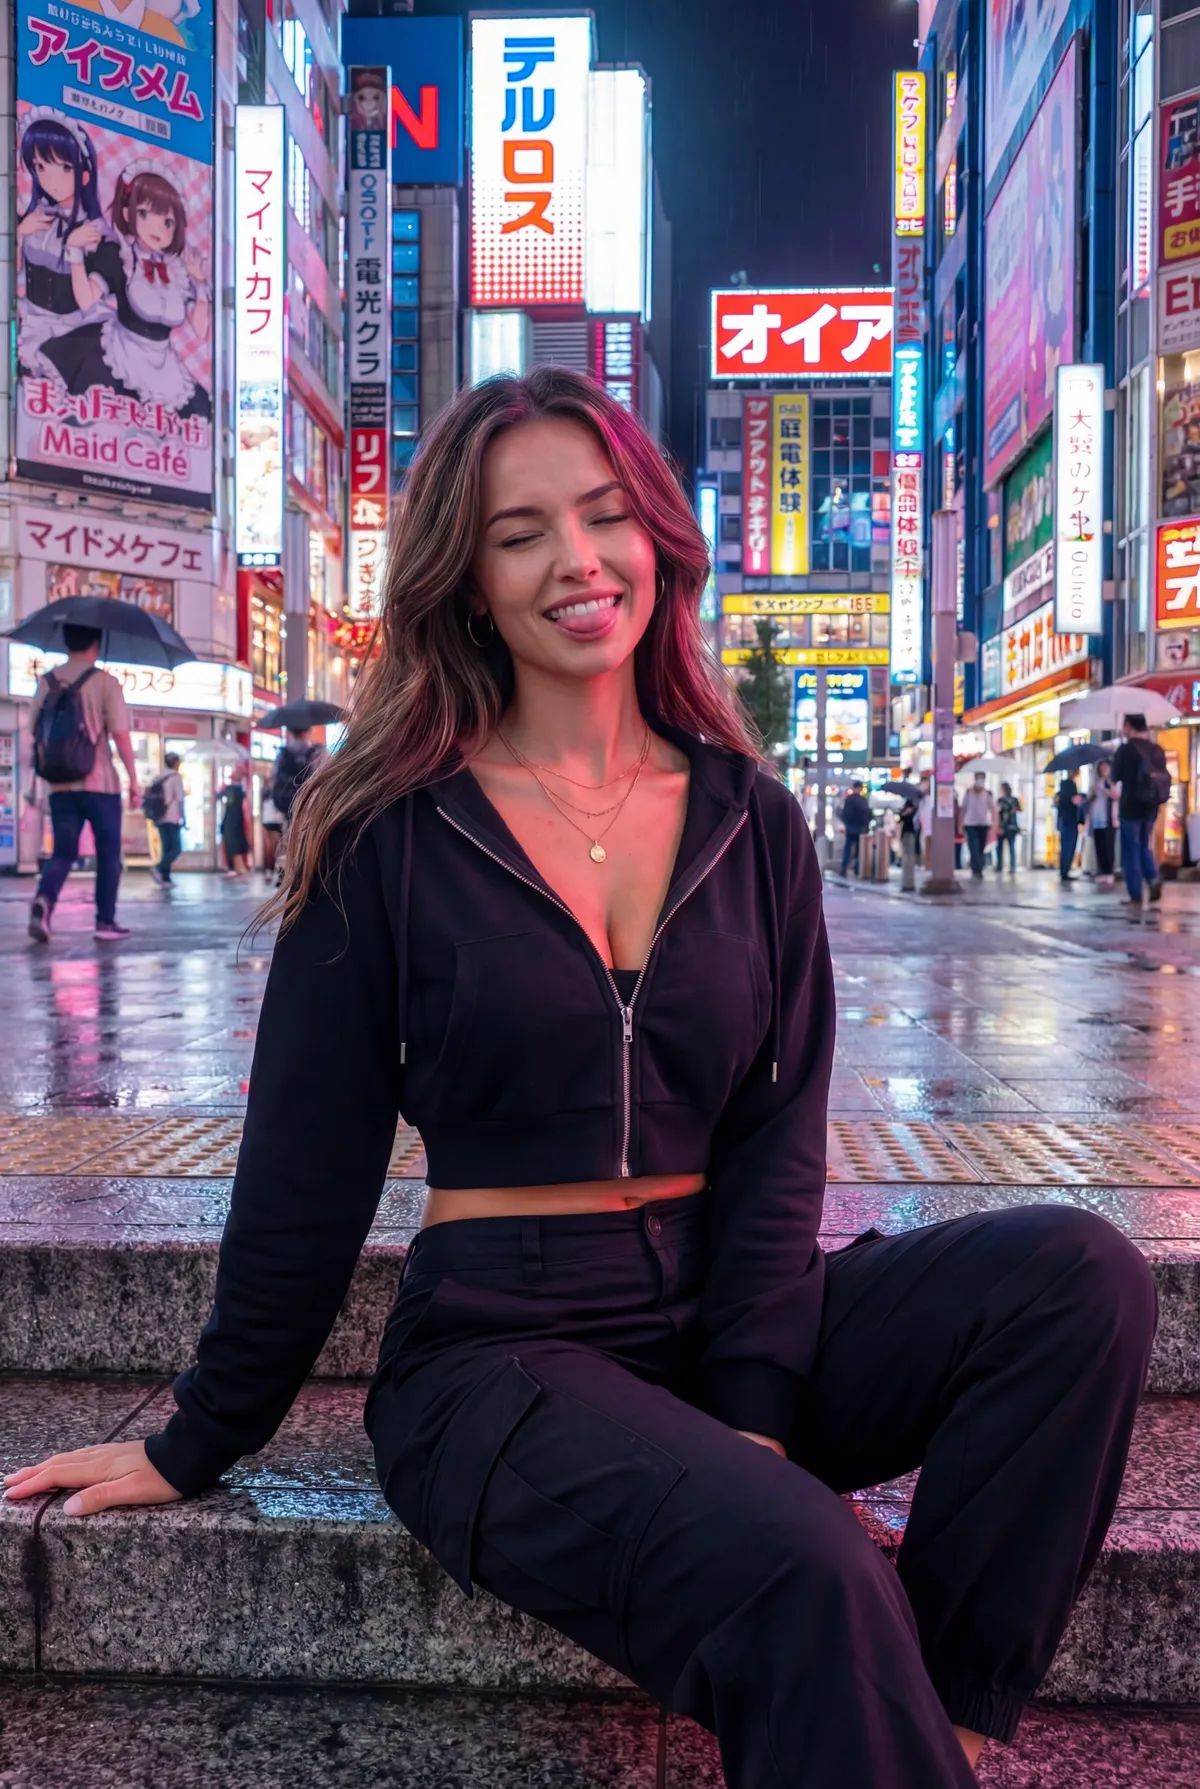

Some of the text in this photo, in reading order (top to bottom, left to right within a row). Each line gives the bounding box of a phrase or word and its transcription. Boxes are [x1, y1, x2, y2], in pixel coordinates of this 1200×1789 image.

[501, 36, 555, 235] テルロス
[720, 303, 893, 363] オイア
[43, 424, 187, 476] Maid Café
